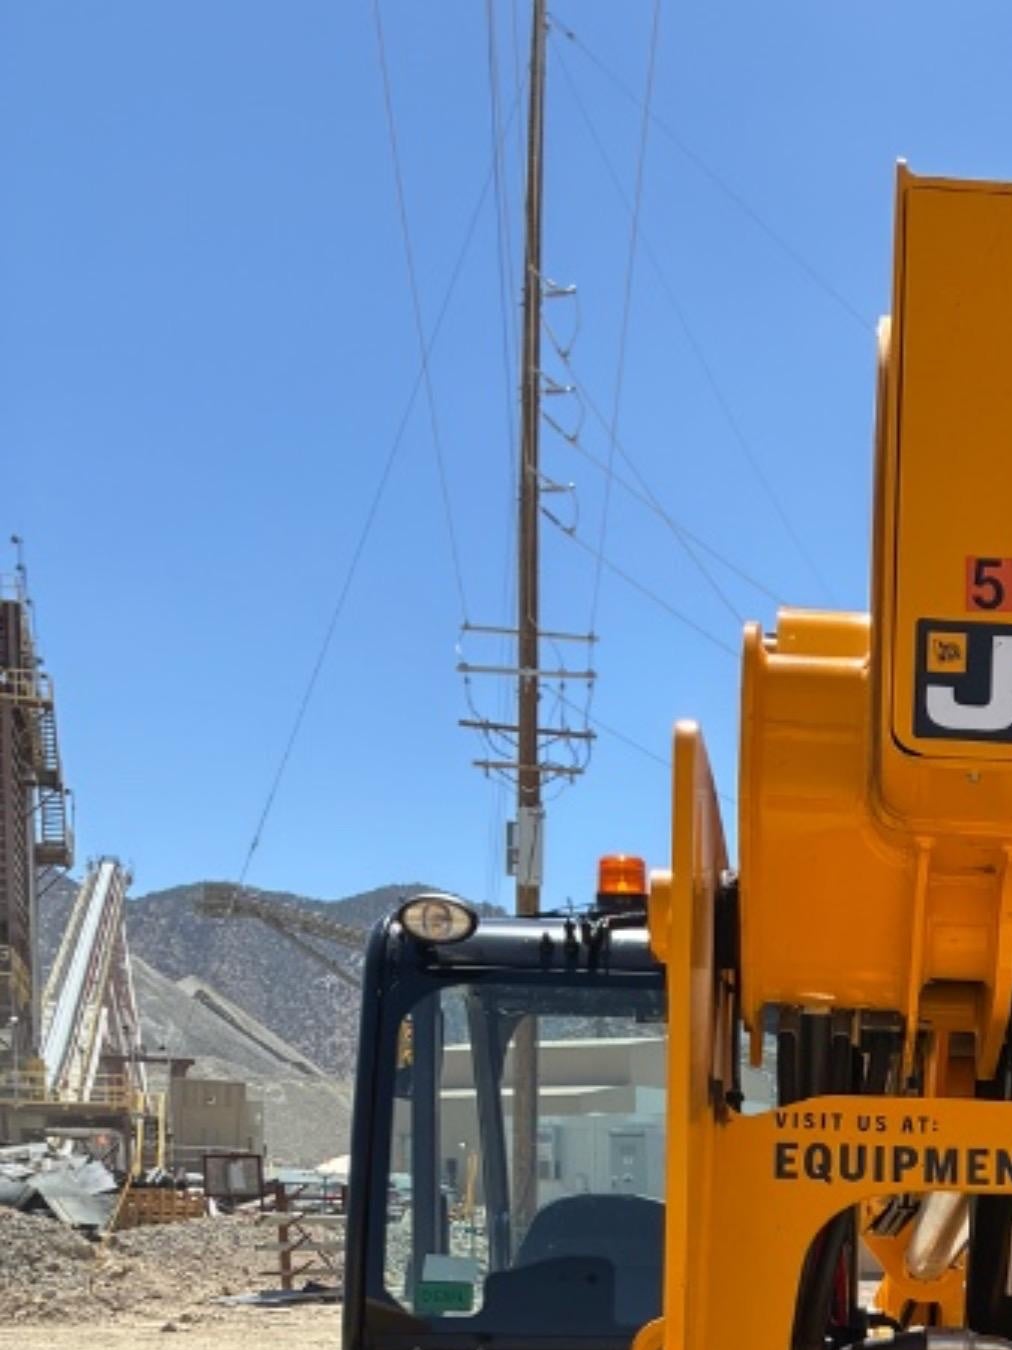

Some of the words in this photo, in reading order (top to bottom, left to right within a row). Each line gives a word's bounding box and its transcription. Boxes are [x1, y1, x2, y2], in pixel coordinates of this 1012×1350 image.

[774, 1112, 843, 1131] VISIT
[857, 1115, 887, 1132] US
[901, 1115, 939, 1133] AT:
